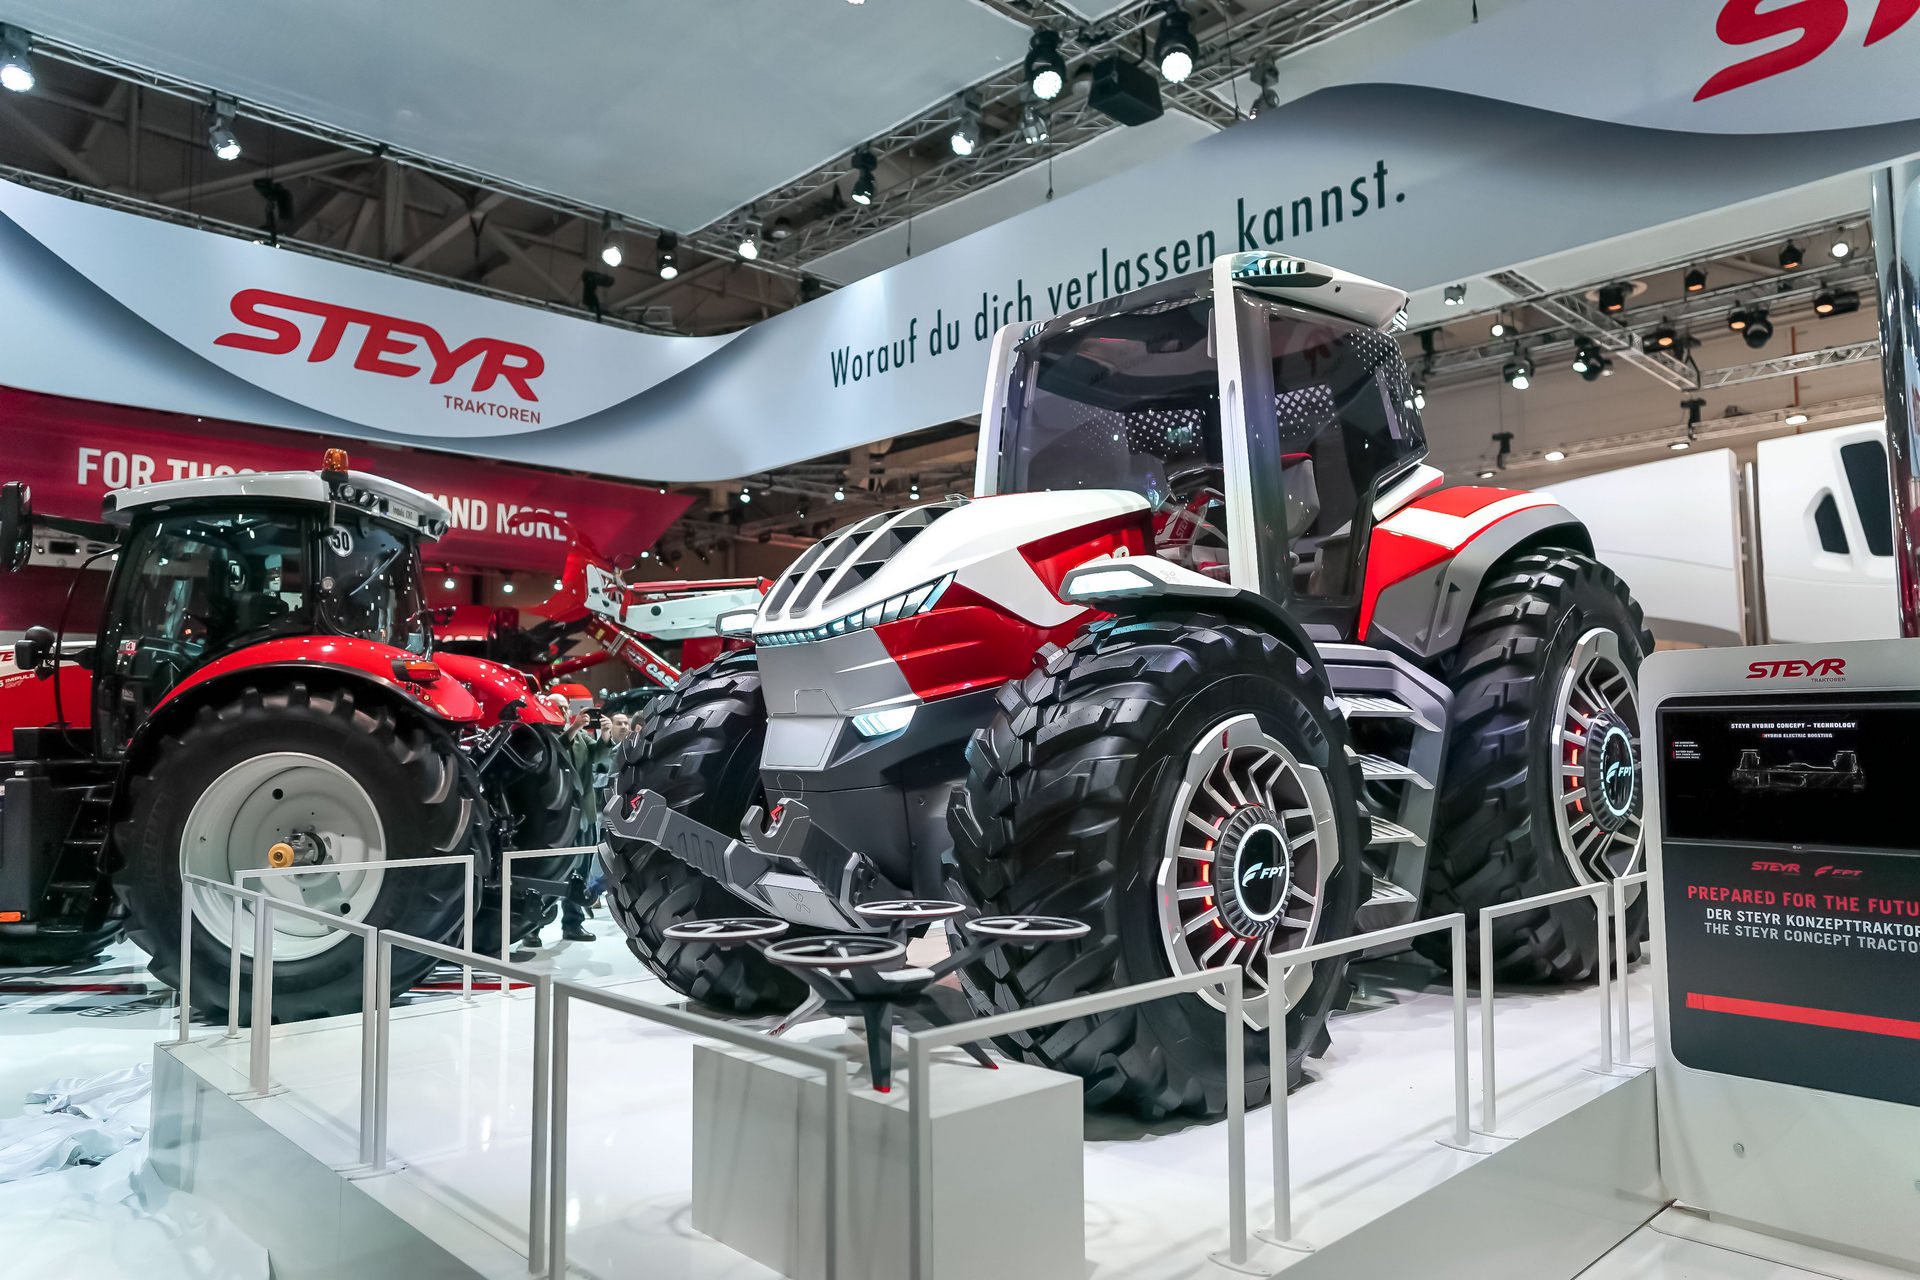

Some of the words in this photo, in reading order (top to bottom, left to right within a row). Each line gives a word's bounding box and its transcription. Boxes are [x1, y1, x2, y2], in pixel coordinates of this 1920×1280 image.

[831, 317, 917, 388] Worauf
[929, 309, 960, 356] du
[974, 279, 1033, 341] dich
[1047, 229, 1215, 316] verlassen
[1237, 159, 1406, 253] kannst.
[212, 288, 545, 402] STEYR
[443, 395, 541, 424] TRAKTOREN
[77, 446, 156, 489] FOR
[331, 528, 351, 551] 50
[5, 673, 36, 684] IMPULS
[1745, 658, 1846, 679] STEYR
[1813, 721, 1856, 729] TECHNOLOGY
[1617, 766, 1632, 777] FPT
[1260, 865, 1286, 879] FPT
[1751, 861, 1801, 873] STEYR
[1832, 868, 1863, 877] FPT
[1687, 885, 1776, 905] PREPARED
[1783, 892, 1817, 909] FOR
[1823, 895, 1860, 912] THE
[1706, 907, 1732, 921] DER
[1736, 911, 1781, 925] STEYR
[1704, 922, 1730, 936] THE
[1734, 925, 1779, 940] STEYR
[1784, 929, 1851, 947] CONCEPT
[1857, 936, 1920, 954] TRACTO
